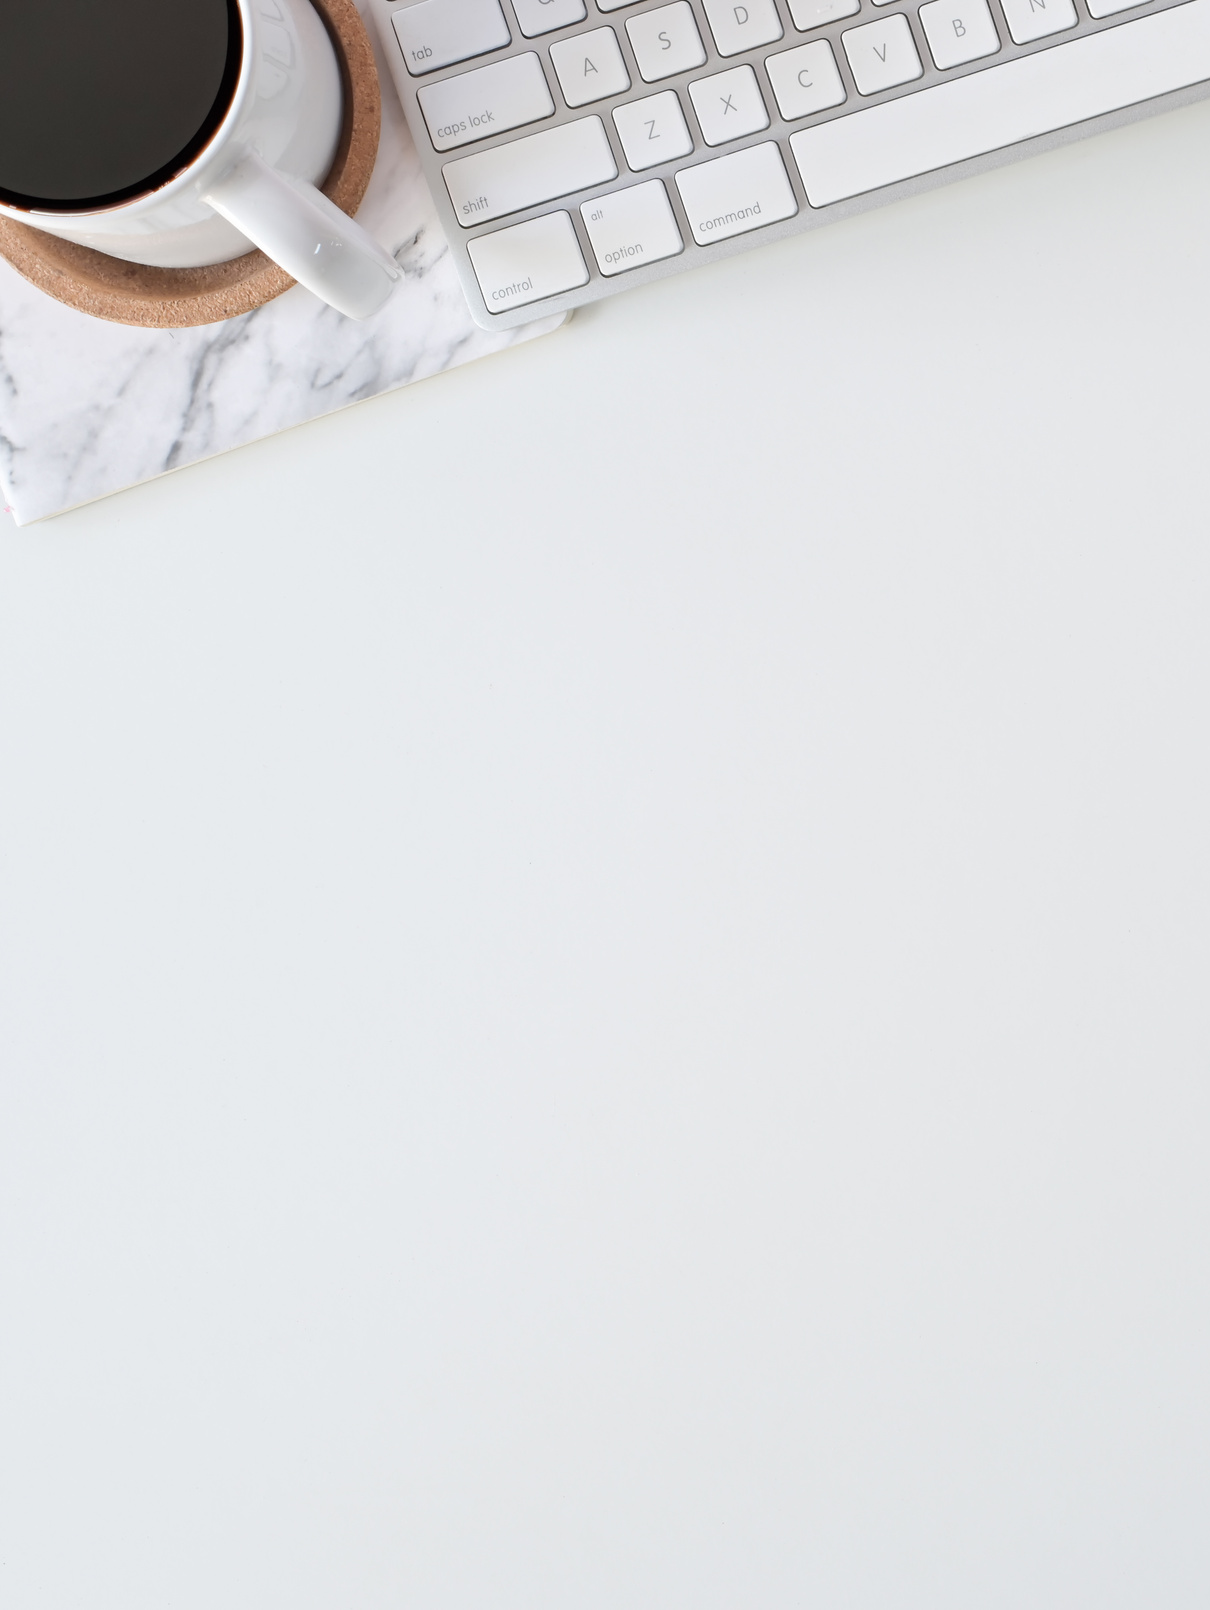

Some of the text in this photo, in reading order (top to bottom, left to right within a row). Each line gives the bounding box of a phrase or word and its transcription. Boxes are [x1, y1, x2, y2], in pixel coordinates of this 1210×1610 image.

[733, 6, 749, 25] D
[952, 19, 967, 38] B
[658, 32, 671, 50] S
[412, 45, 433, 61] tab
[872, 43, 887, 63] V
[584, 57, 599, 77] A
[797, 69, 813, 88] C
[720, 94, 738, 116] X
[437, 110, 496, 139] caps lock
[644, 120, 660, 140] Z
[462, 196, 489, 215] shift
[591, 210, 604, 222] alt
[698, 201, 762, 233] command
[604, 243, 645, 264] option
[491, 277, 534, 301] control
